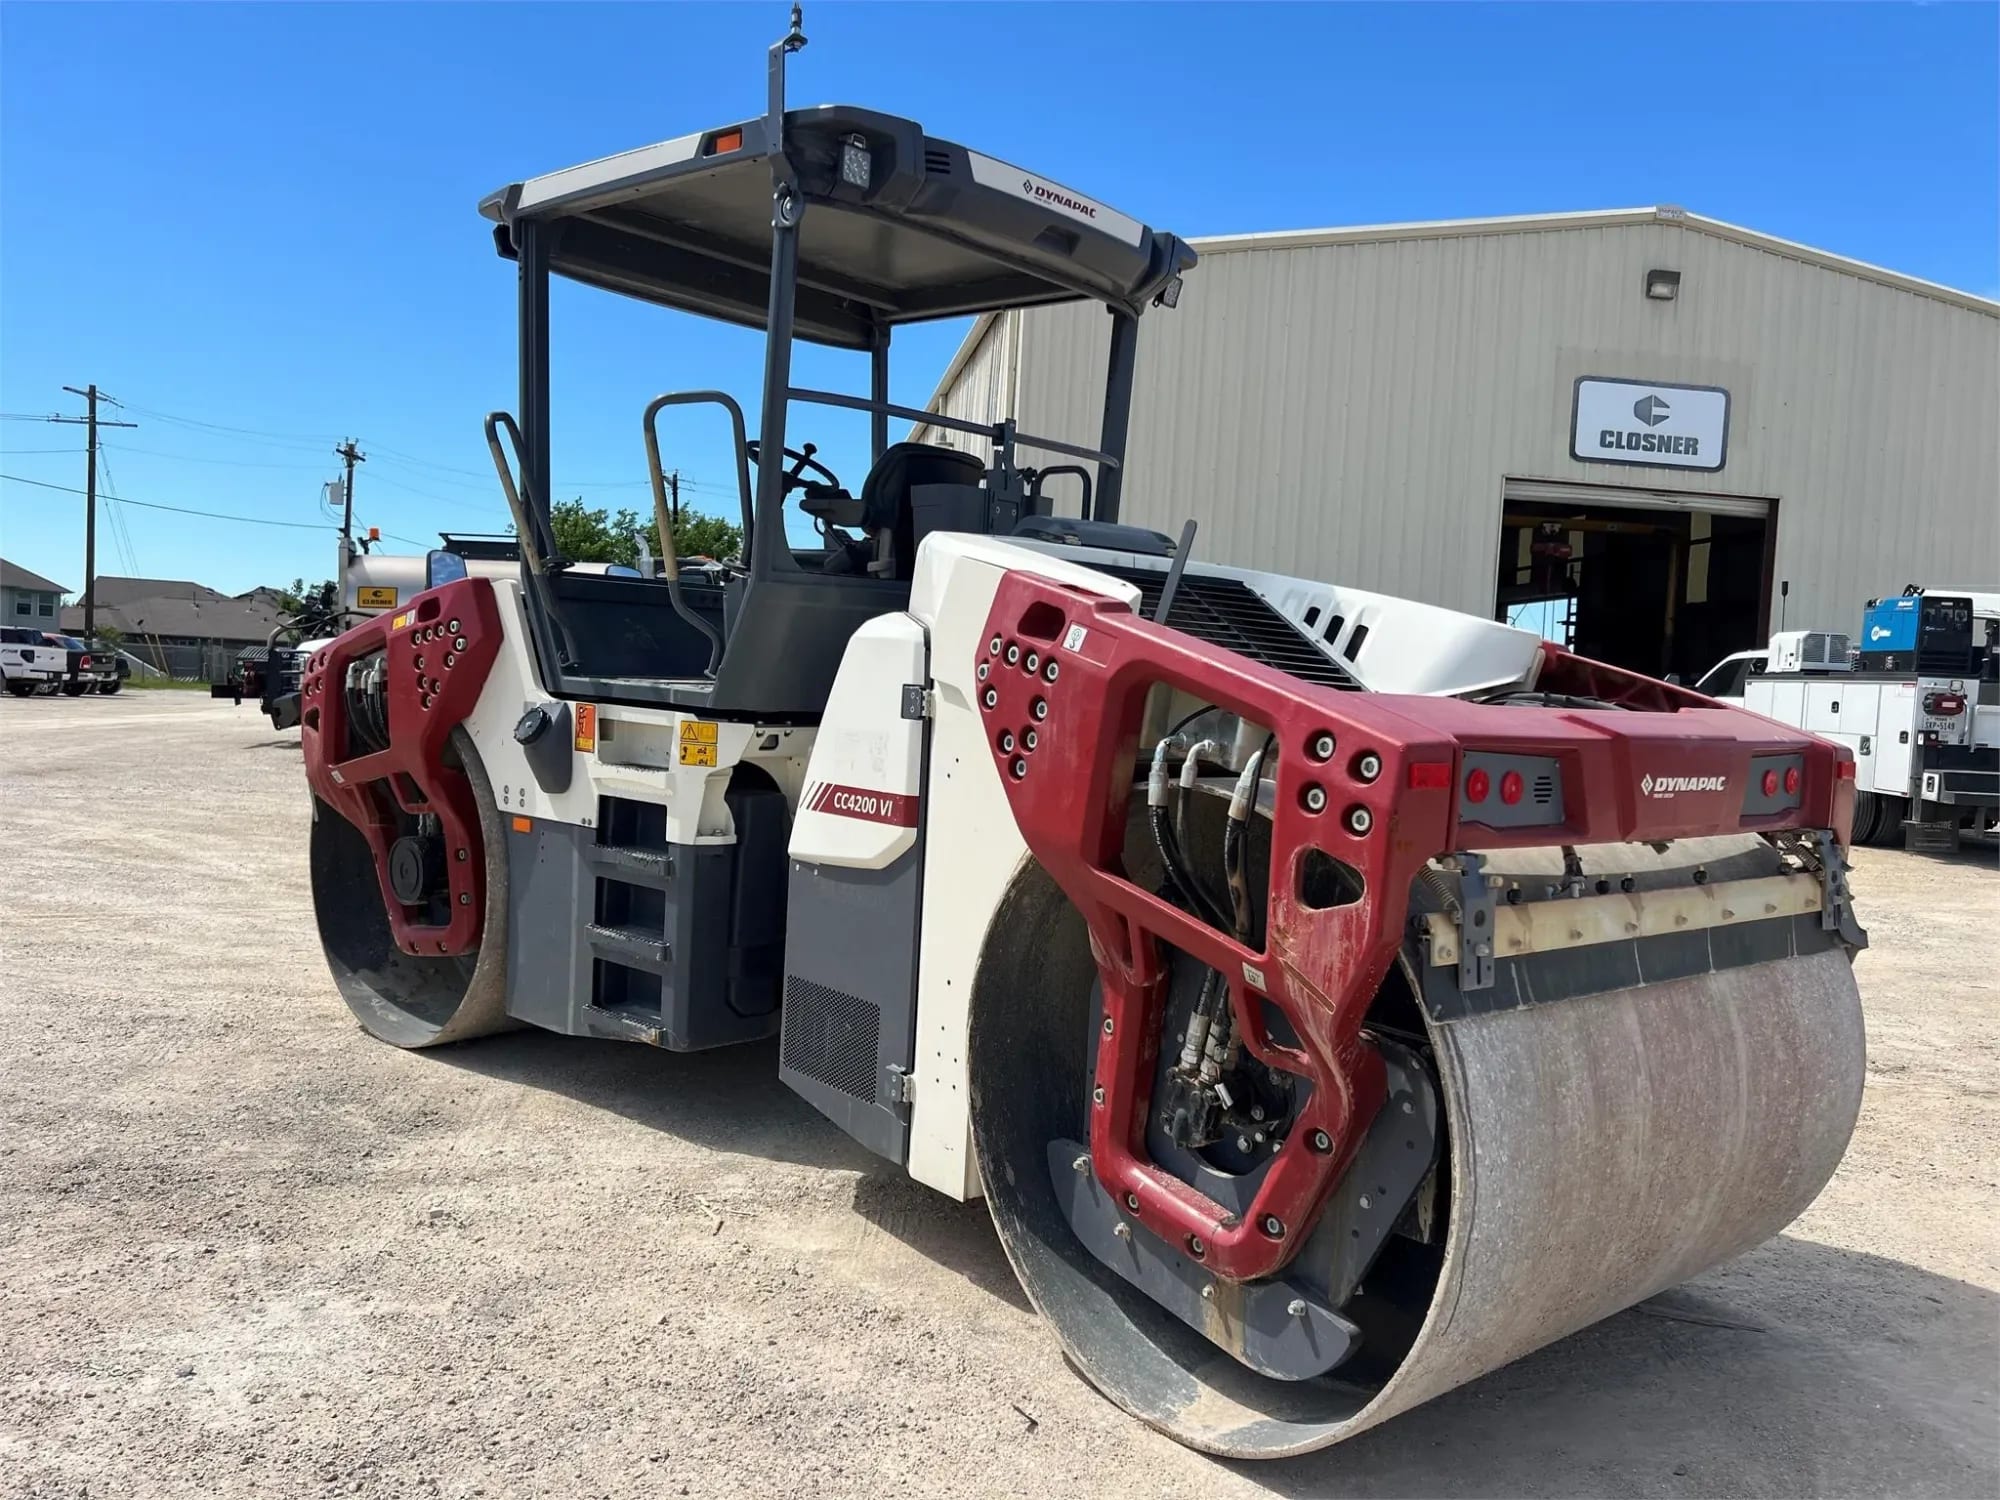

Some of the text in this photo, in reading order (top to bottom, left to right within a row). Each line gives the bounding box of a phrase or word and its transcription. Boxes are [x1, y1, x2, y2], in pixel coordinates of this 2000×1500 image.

[1034, 186, 1097, 219] DYNAPAC
[1599, 429, 1699, 456] CLOSNER
[1653, 776, 1726, 792] DYNAPAC
[833, 792, 893, 817] CC4200 VI
